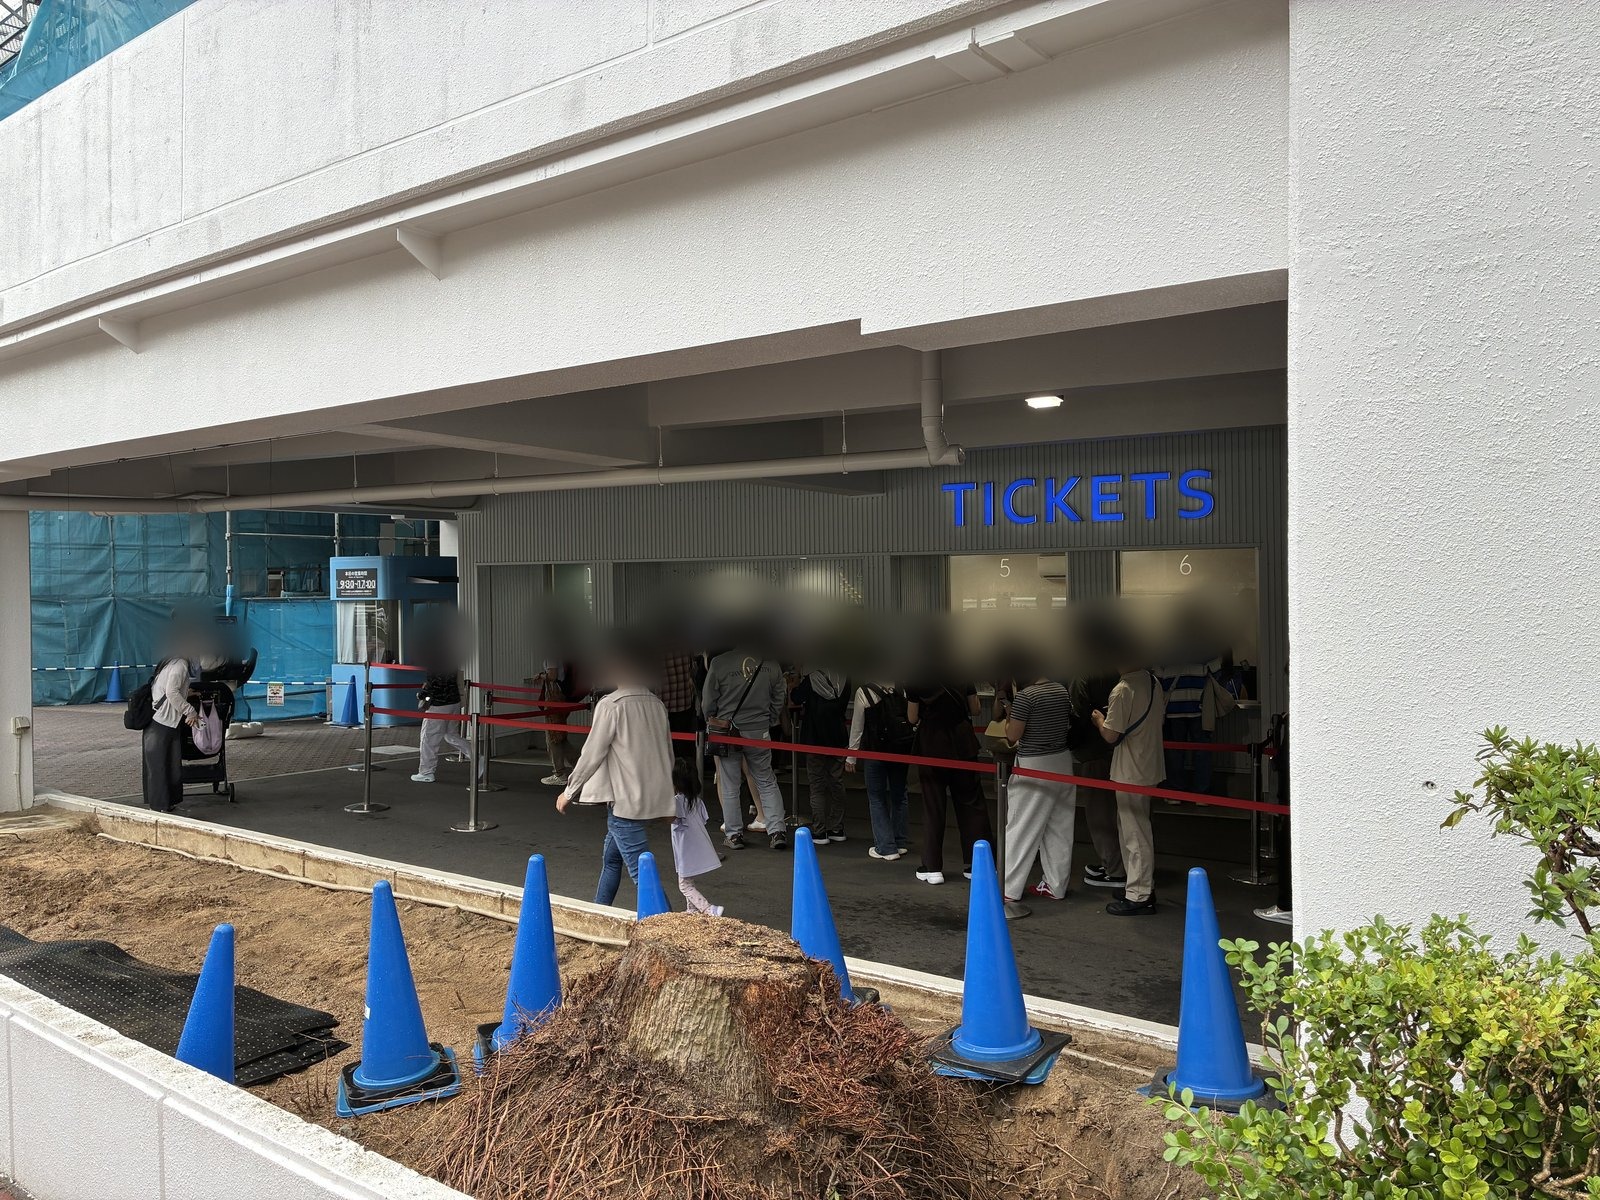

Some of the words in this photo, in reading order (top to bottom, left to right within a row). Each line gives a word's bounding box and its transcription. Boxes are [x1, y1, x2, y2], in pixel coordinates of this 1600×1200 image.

[941, 469, 1215, 527] TICKETS
[999, 558, 1011, 578] 5
[1180, 555, 1192, 575] 6
